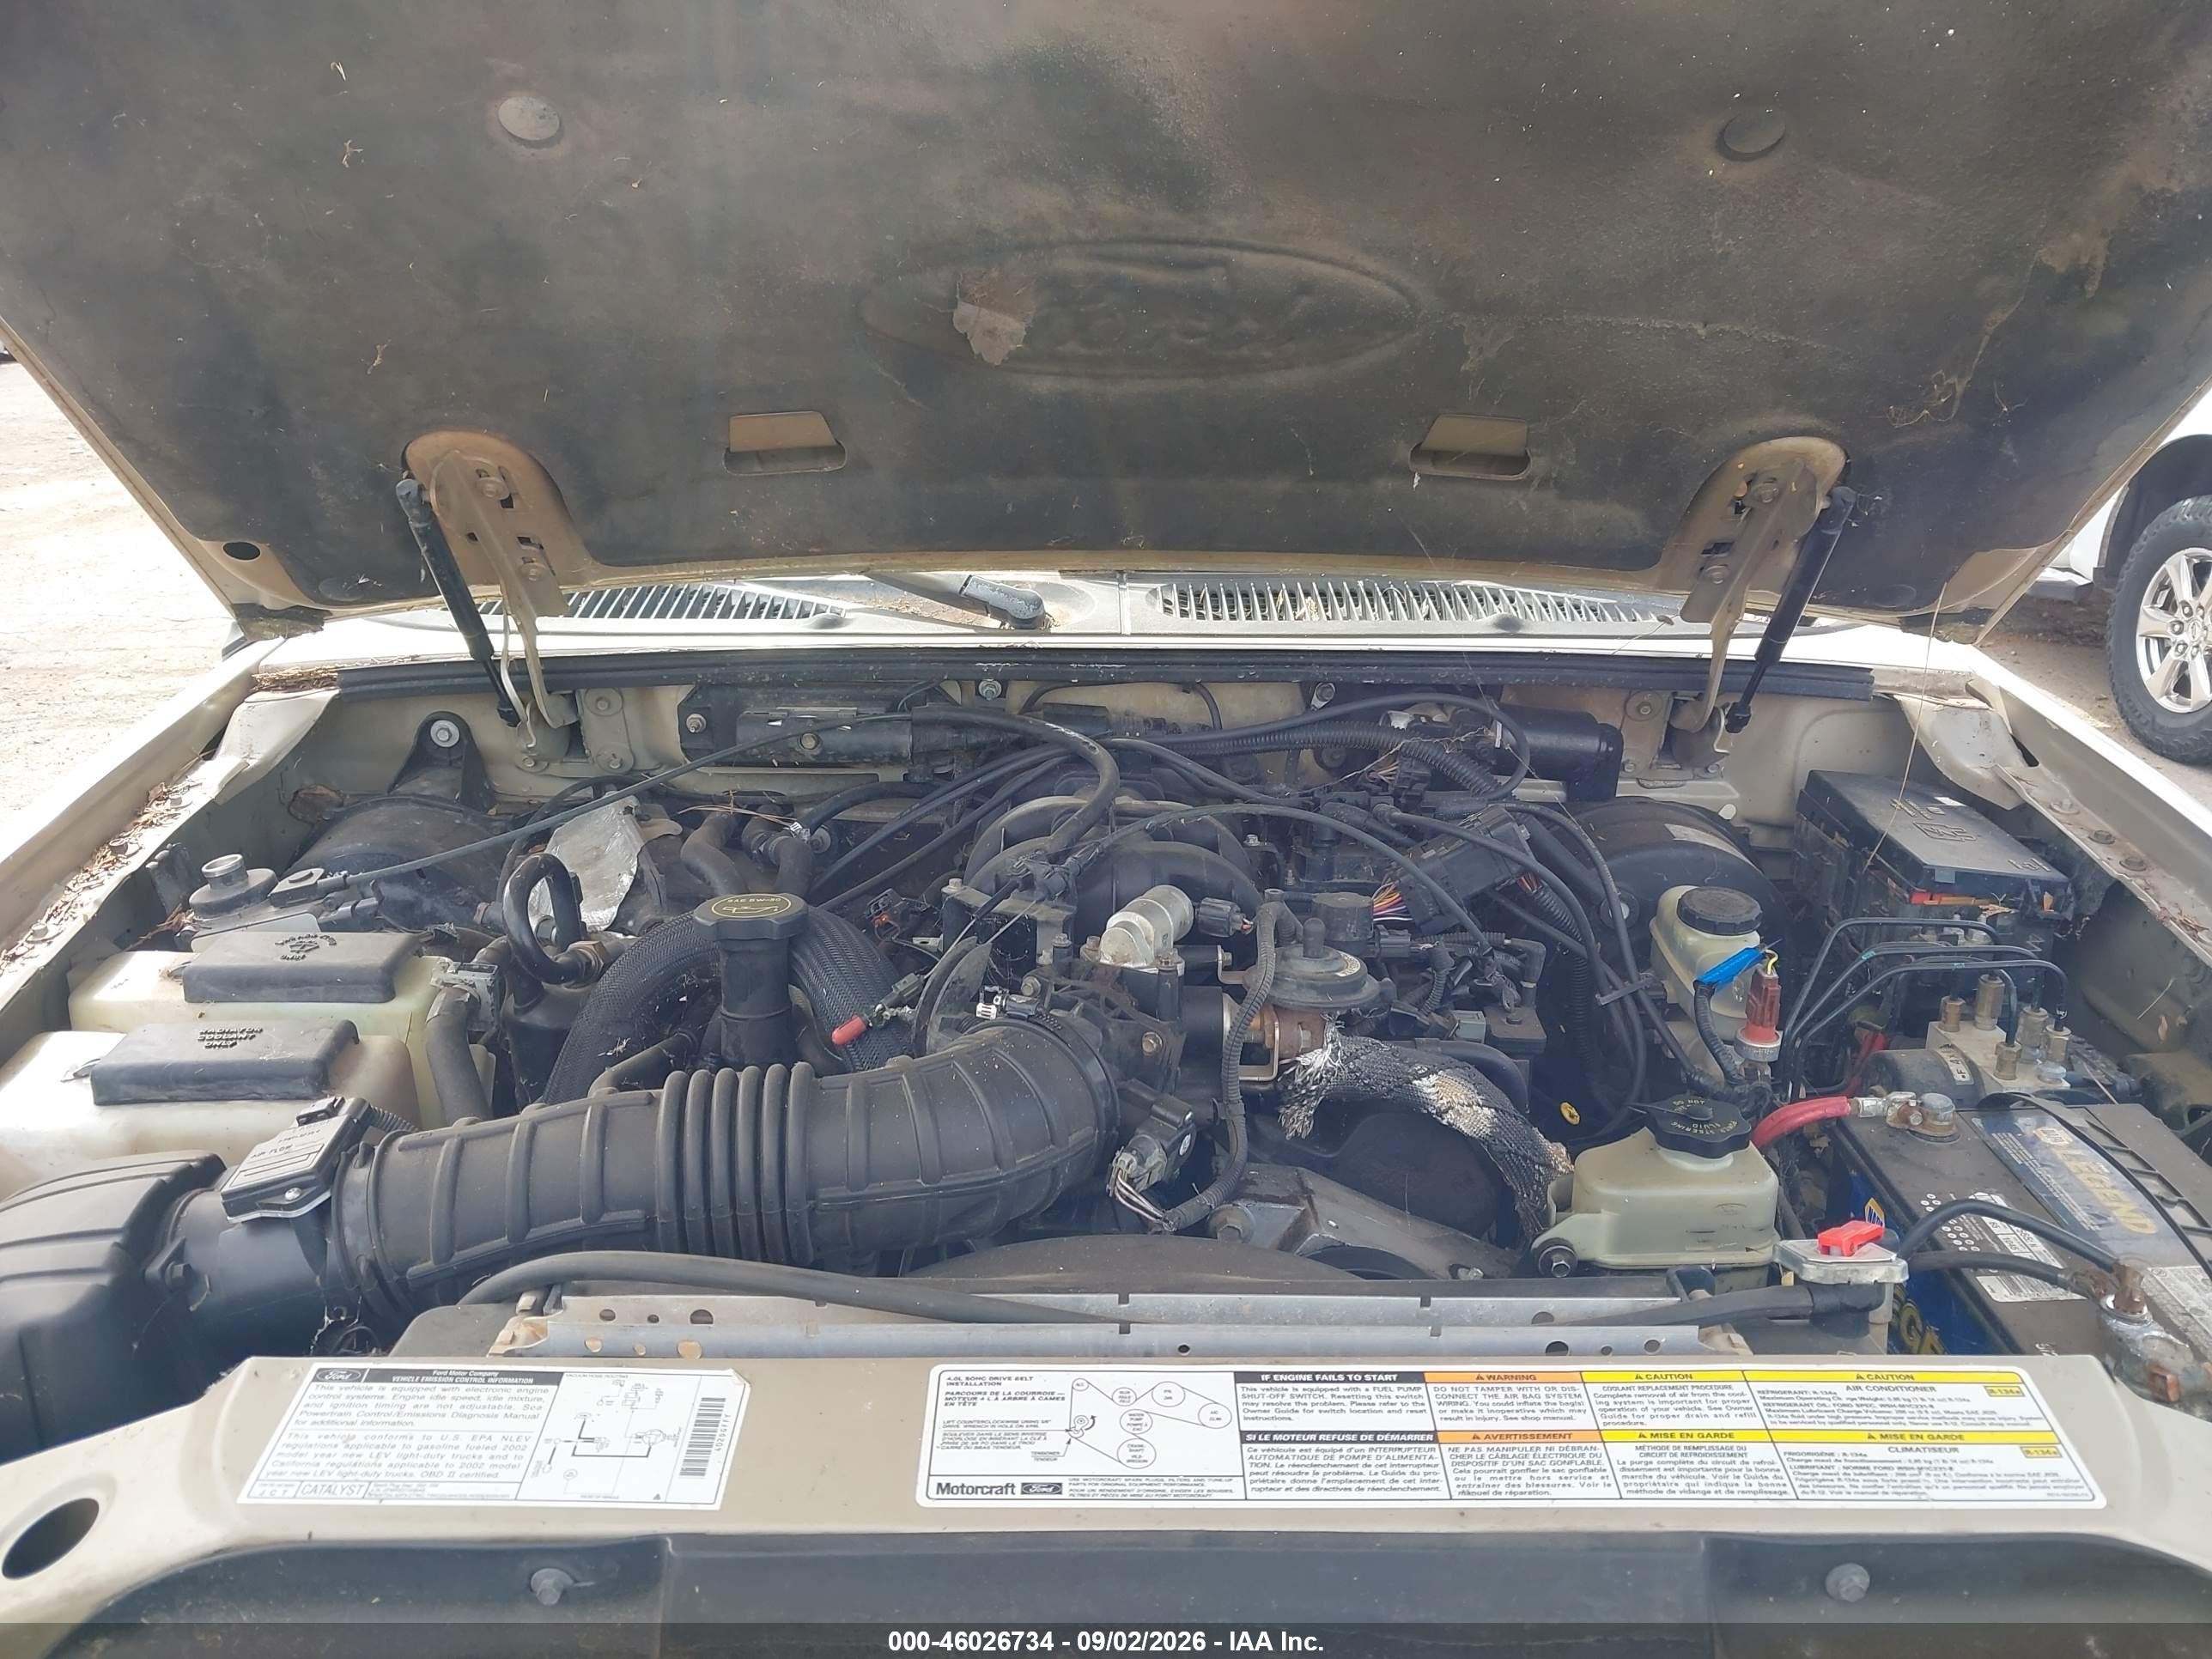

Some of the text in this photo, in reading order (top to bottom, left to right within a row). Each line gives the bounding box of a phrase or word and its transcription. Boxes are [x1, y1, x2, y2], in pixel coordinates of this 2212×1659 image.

[197, 1033, 256, 1042] COOLANT
[325, 1370, 352, 1380] Ford
[301, 1484, 364, 1495] CATALYST
[936, 1482, 1016, 1495] Motorcraft
